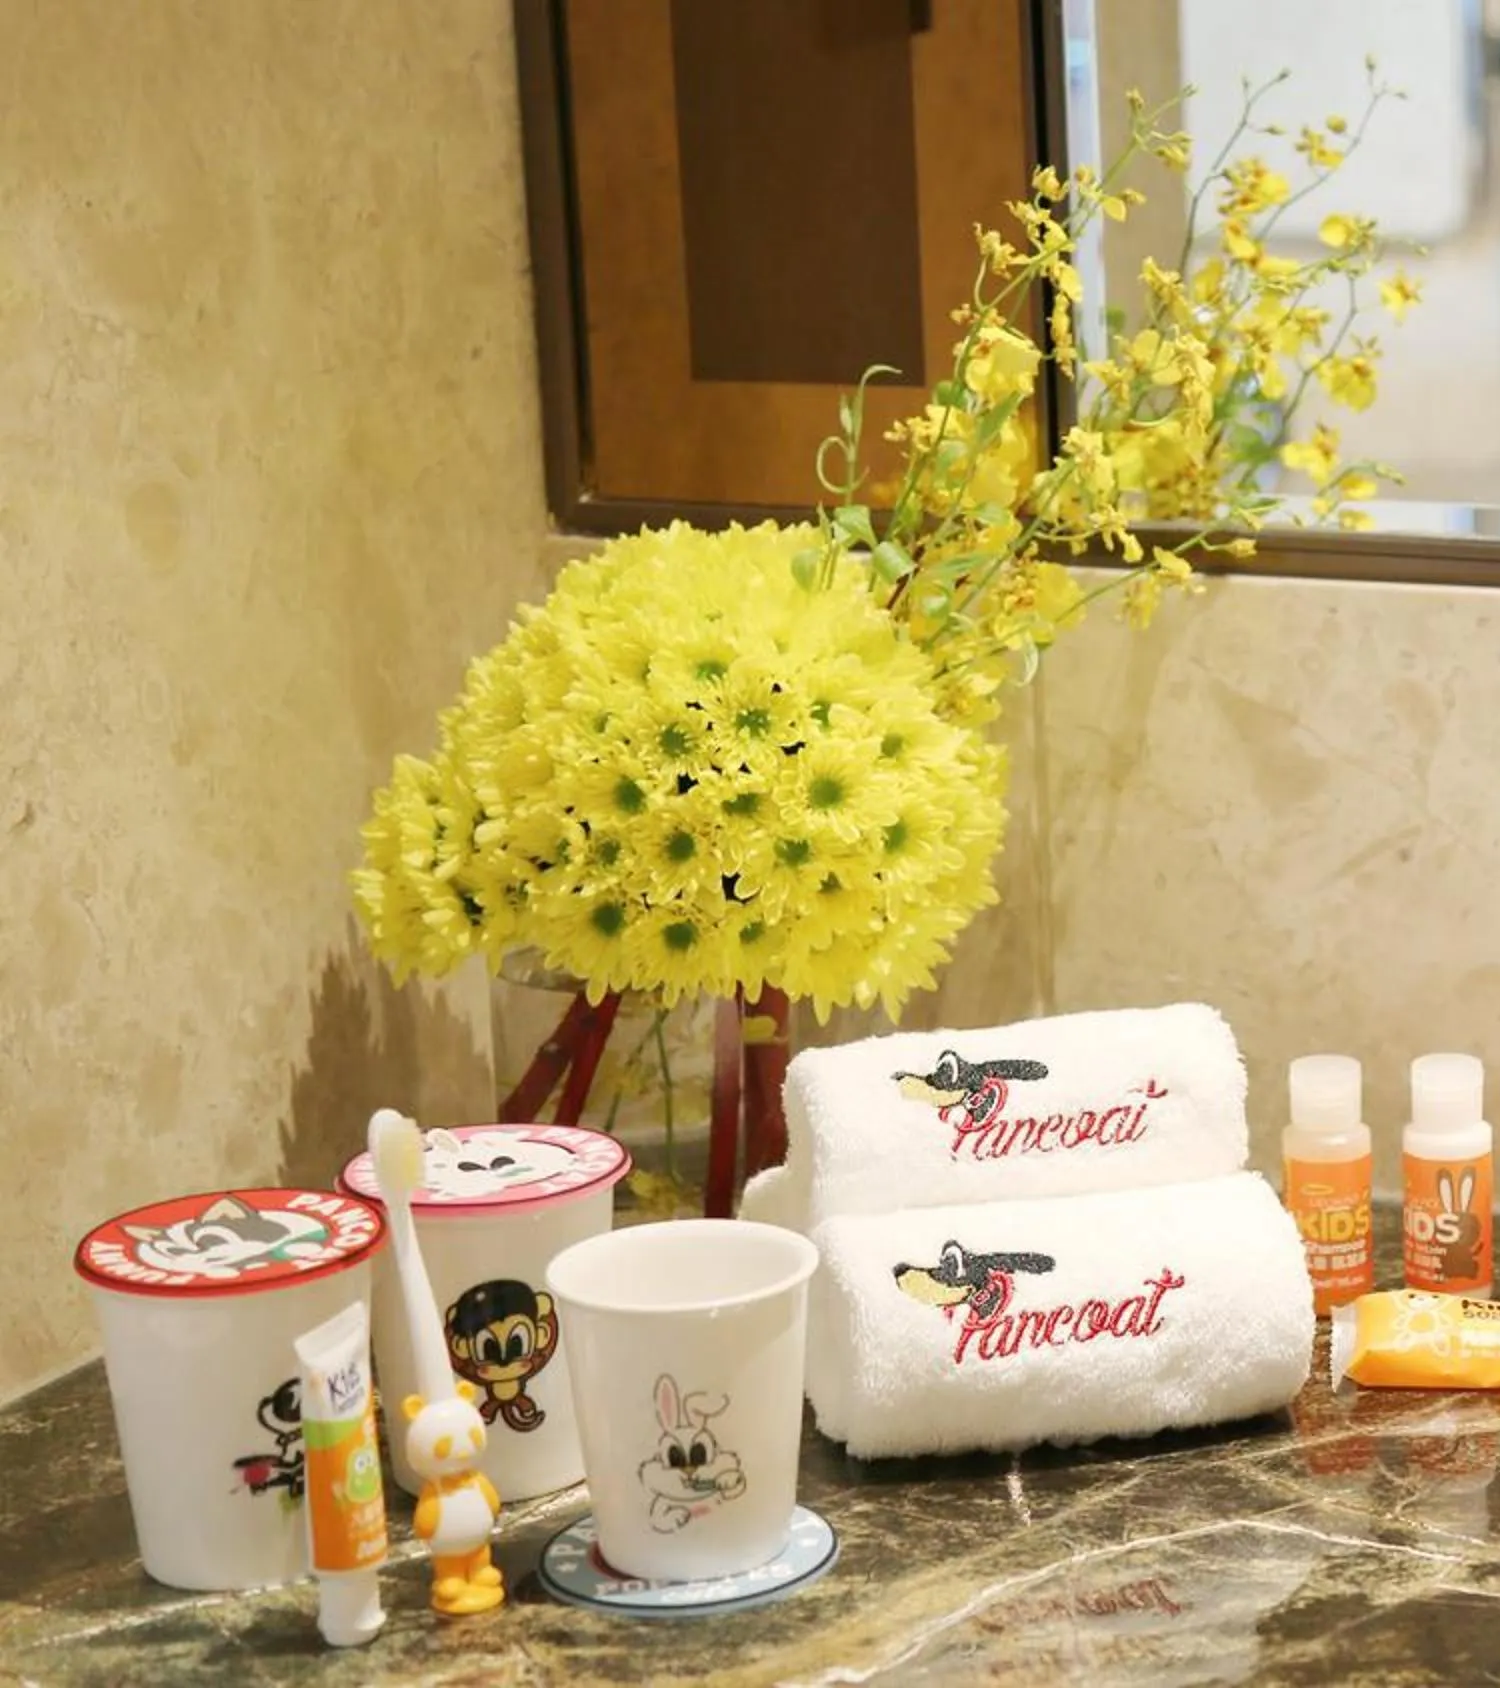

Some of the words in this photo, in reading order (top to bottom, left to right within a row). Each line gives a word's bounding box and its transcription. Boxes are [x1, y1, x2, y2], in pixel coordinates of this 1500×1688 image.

[938, 1078, 1168, 1160] Pancoat
[1403, 1207, 1460, 1244] IDS
[943, 1267, 1186, 1365] Pancoat
